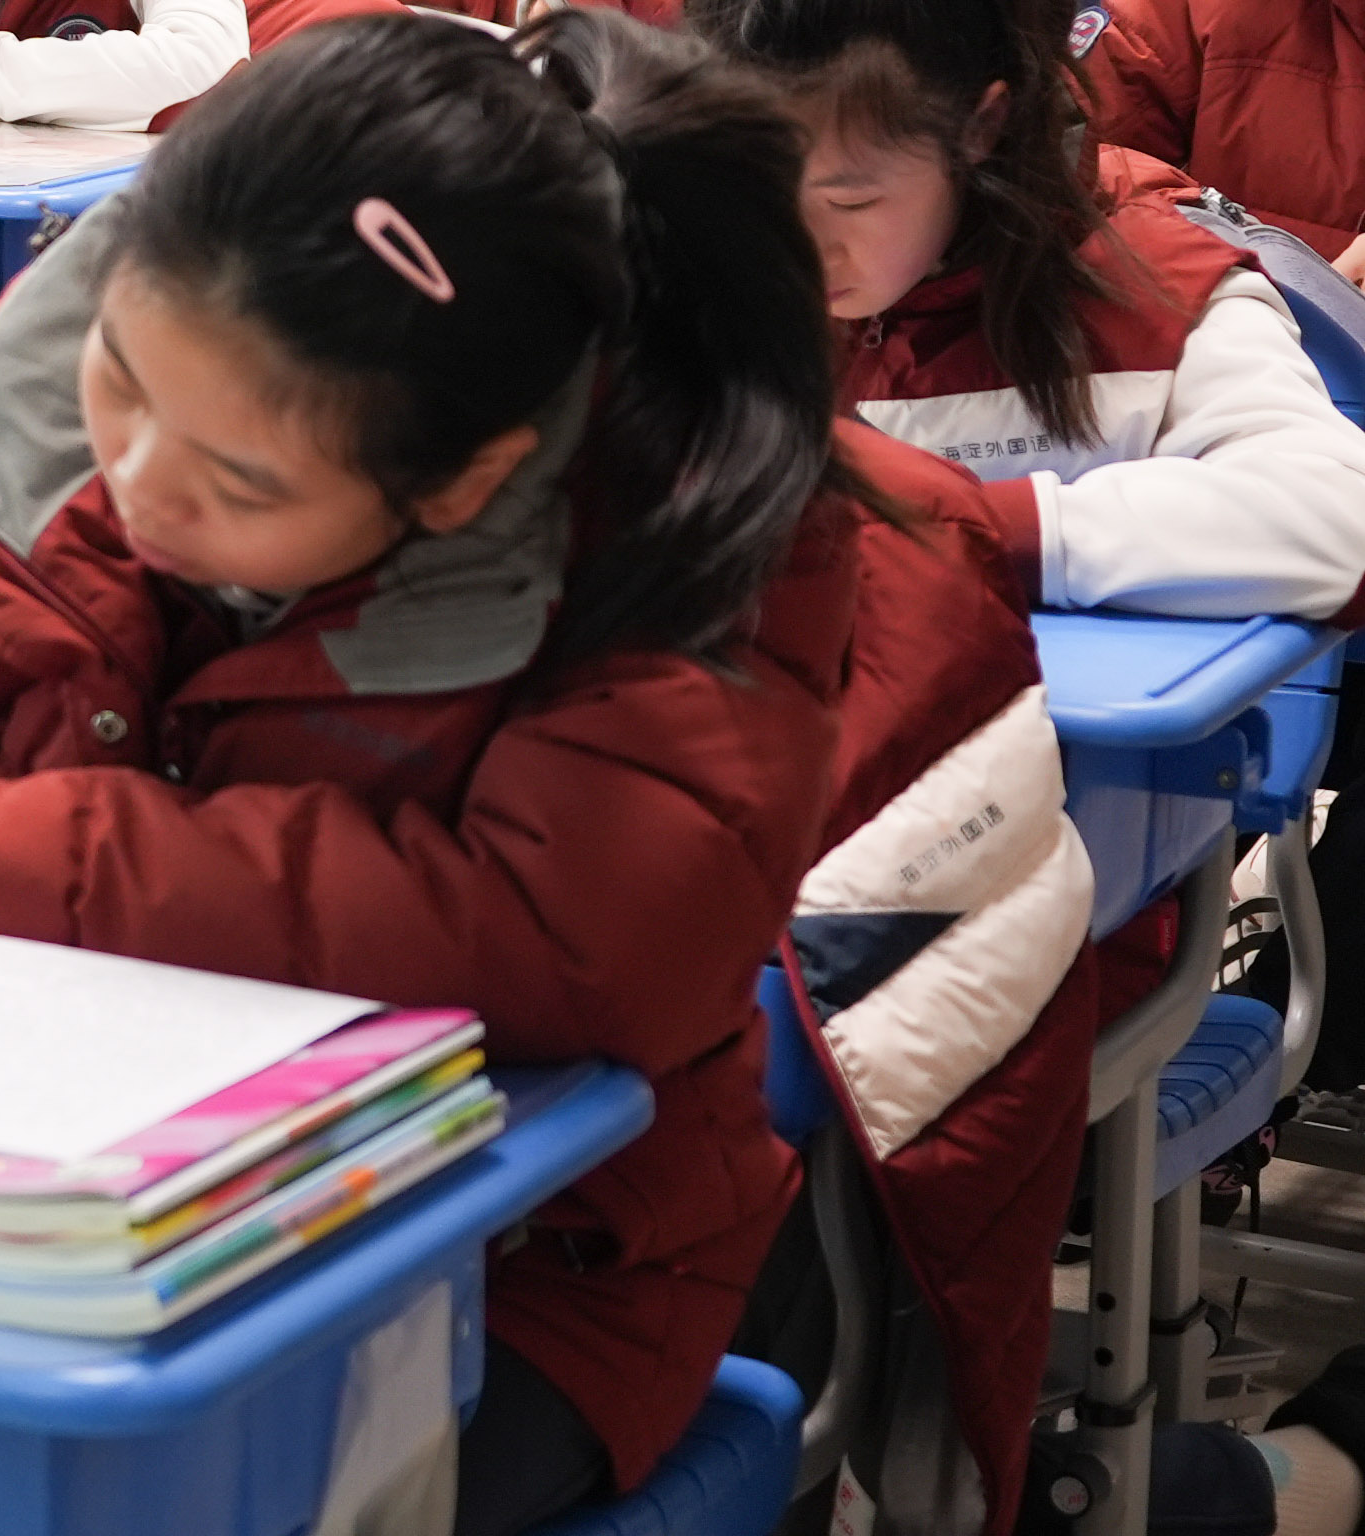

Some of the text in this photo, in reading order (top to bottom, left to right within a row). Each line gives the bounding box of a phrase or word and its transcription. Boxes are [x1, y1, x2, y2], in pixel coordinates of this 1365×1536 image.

[940, 435, 1052, 460] 海淀外国语
